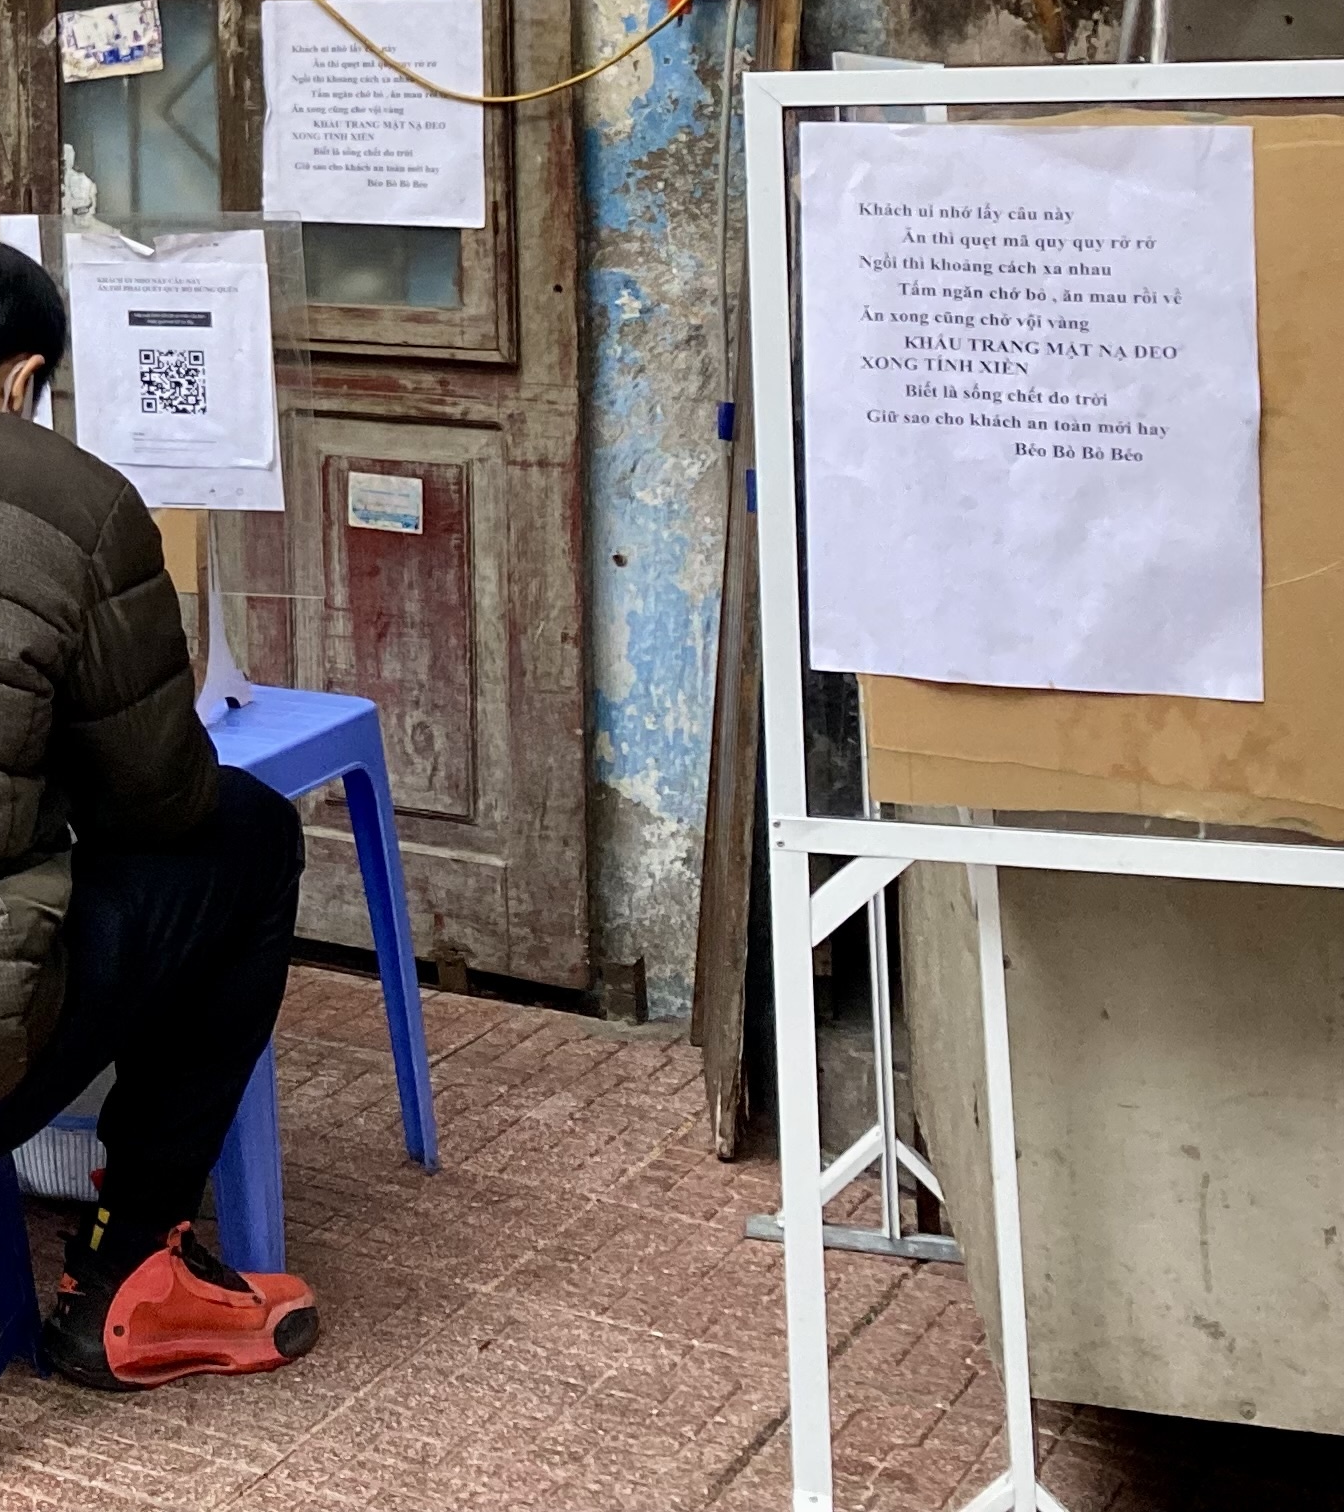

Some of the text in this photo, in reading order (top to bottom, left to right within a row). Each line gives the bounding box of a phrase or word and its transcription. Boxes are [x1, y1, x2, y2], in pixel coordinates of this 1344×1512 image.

[859, 202, 912, 217] Khách
[939, 206, 972, 219] nhớ
[978, 203, 1001, 224] lấy
[1008, 206, 1037, 220] câu
[1043, 207, 1074, 225] này
[902, 227, 925, 245] Ăn
[932, 231, 955, 245] thì
[960, 234, 998, 248] quẹt
[1035, 237, 1065, 251] quy
[1073, 238, 1104, 253] quy
[858, 253, 1112, 276] Ngồi thì khoảng cách xa nhau
[898, 279, 936, 297] Tấm
[943, 285, 983, 301] ngăn
[1062, 288, 1083, 303] ăn
[1089, 292, 1127, 303] mau
[1133, 285, 1158, 304] rồi
[1163, 288, 1182, 304] về
[860, 305, 884, 322] Ăn
[890, 313, 929, 326] xong
[934, 311, 975, 329] cũng
[1016, 314, 1042, 331] vội
[1047, 316, 1090, 333] vàng
[967, 337, 1040, 355] TRANG
[1098, 344, 1127, 362] NẠ
[860, 355, 918, 372] XONG
[924, 354, 973, 373] TÍNH
[905, 380, 1108, 407] Biết là sống chết do trời
[867, 409, 1170, 440] Giữ sao cho khách an toàn mới hay
[1015, 441, 1046, 457] Béo
[1111, 447, 1143, 463] Béo
